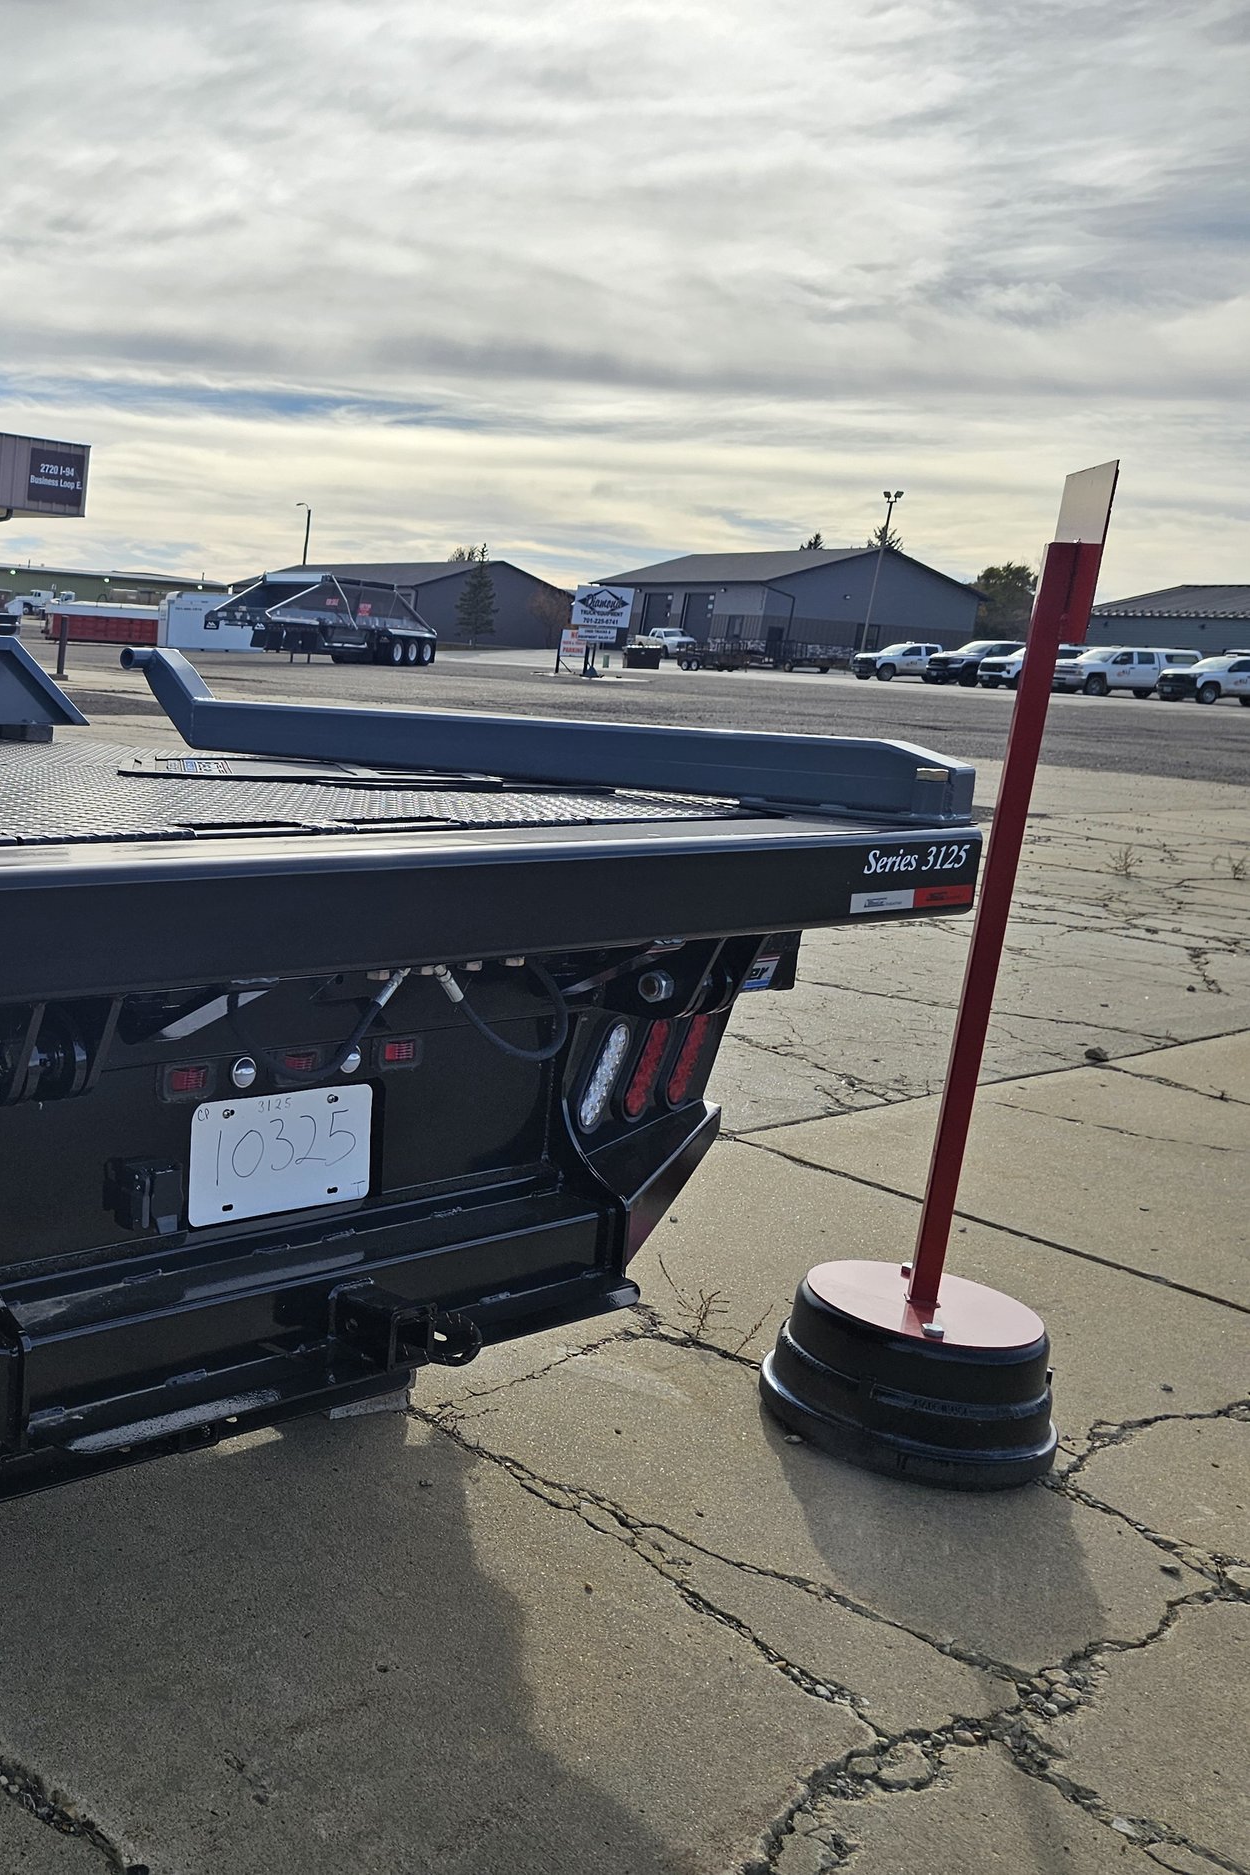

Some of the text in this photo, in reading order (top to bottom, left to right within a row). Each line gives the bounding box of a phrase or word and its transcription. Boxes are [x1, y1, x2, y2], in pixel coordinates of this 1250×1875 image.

[40, 463, 75, 477] 2720 I-94
[30, 475, 58, 486] Business
[60, 479, 75, 490] Loop
[586, 594, 623, 609] Diamond
[863, 844, 970, 875] Series 3125
[257, 1097, 292, 1113] 3125
[215, 1109, 357, 1187] 10325
